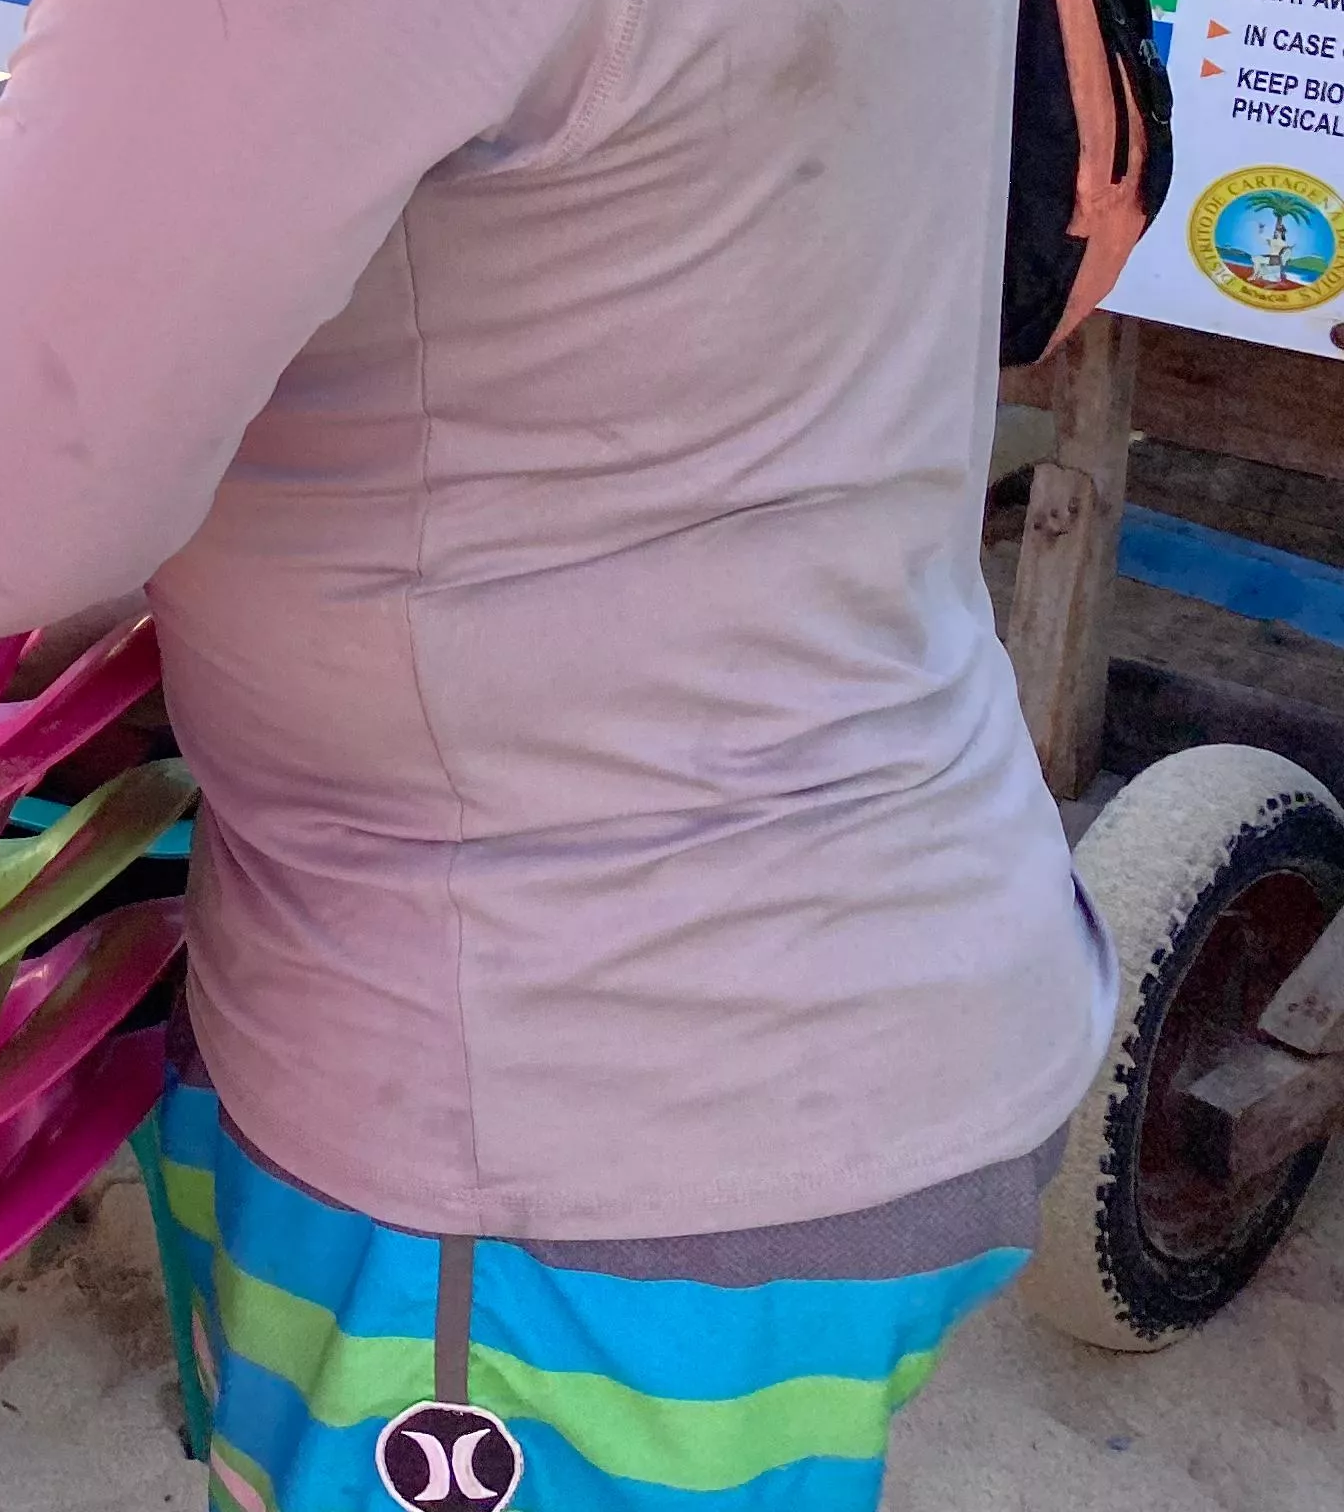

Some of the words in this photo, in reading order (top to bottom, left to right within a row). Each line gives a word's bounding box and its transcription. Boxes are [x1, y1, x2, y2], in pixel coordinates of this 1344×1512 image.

[1244, 24, 1267, 47] IN
[1273, 29, 1337, 60] CASE
[1237, 67, 1298, 96] KEEP
[1231, 97, 1344, 138] PHYSICAL
